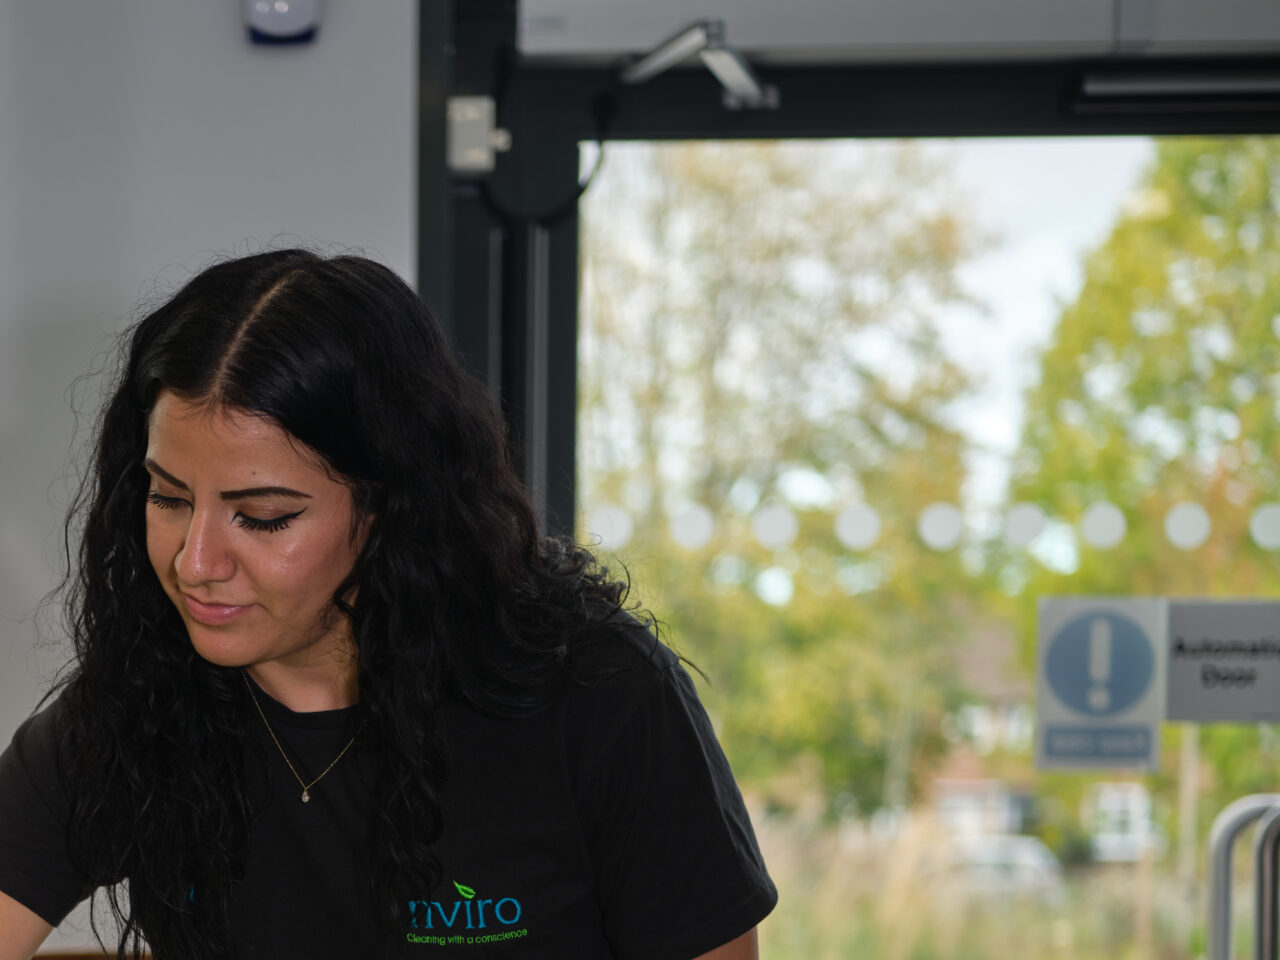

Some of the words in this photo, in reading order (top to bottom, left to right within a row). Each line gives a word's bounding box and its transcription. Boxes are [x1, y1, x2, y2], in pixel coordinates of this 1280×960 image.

[1201, 664, 1257, 688] Door
[406, 932, 446, 946] Cleaning
[447, 934, 465, 944] with
[466, 936, 474, 944] a
[475, 927, 528, 943] conscience
